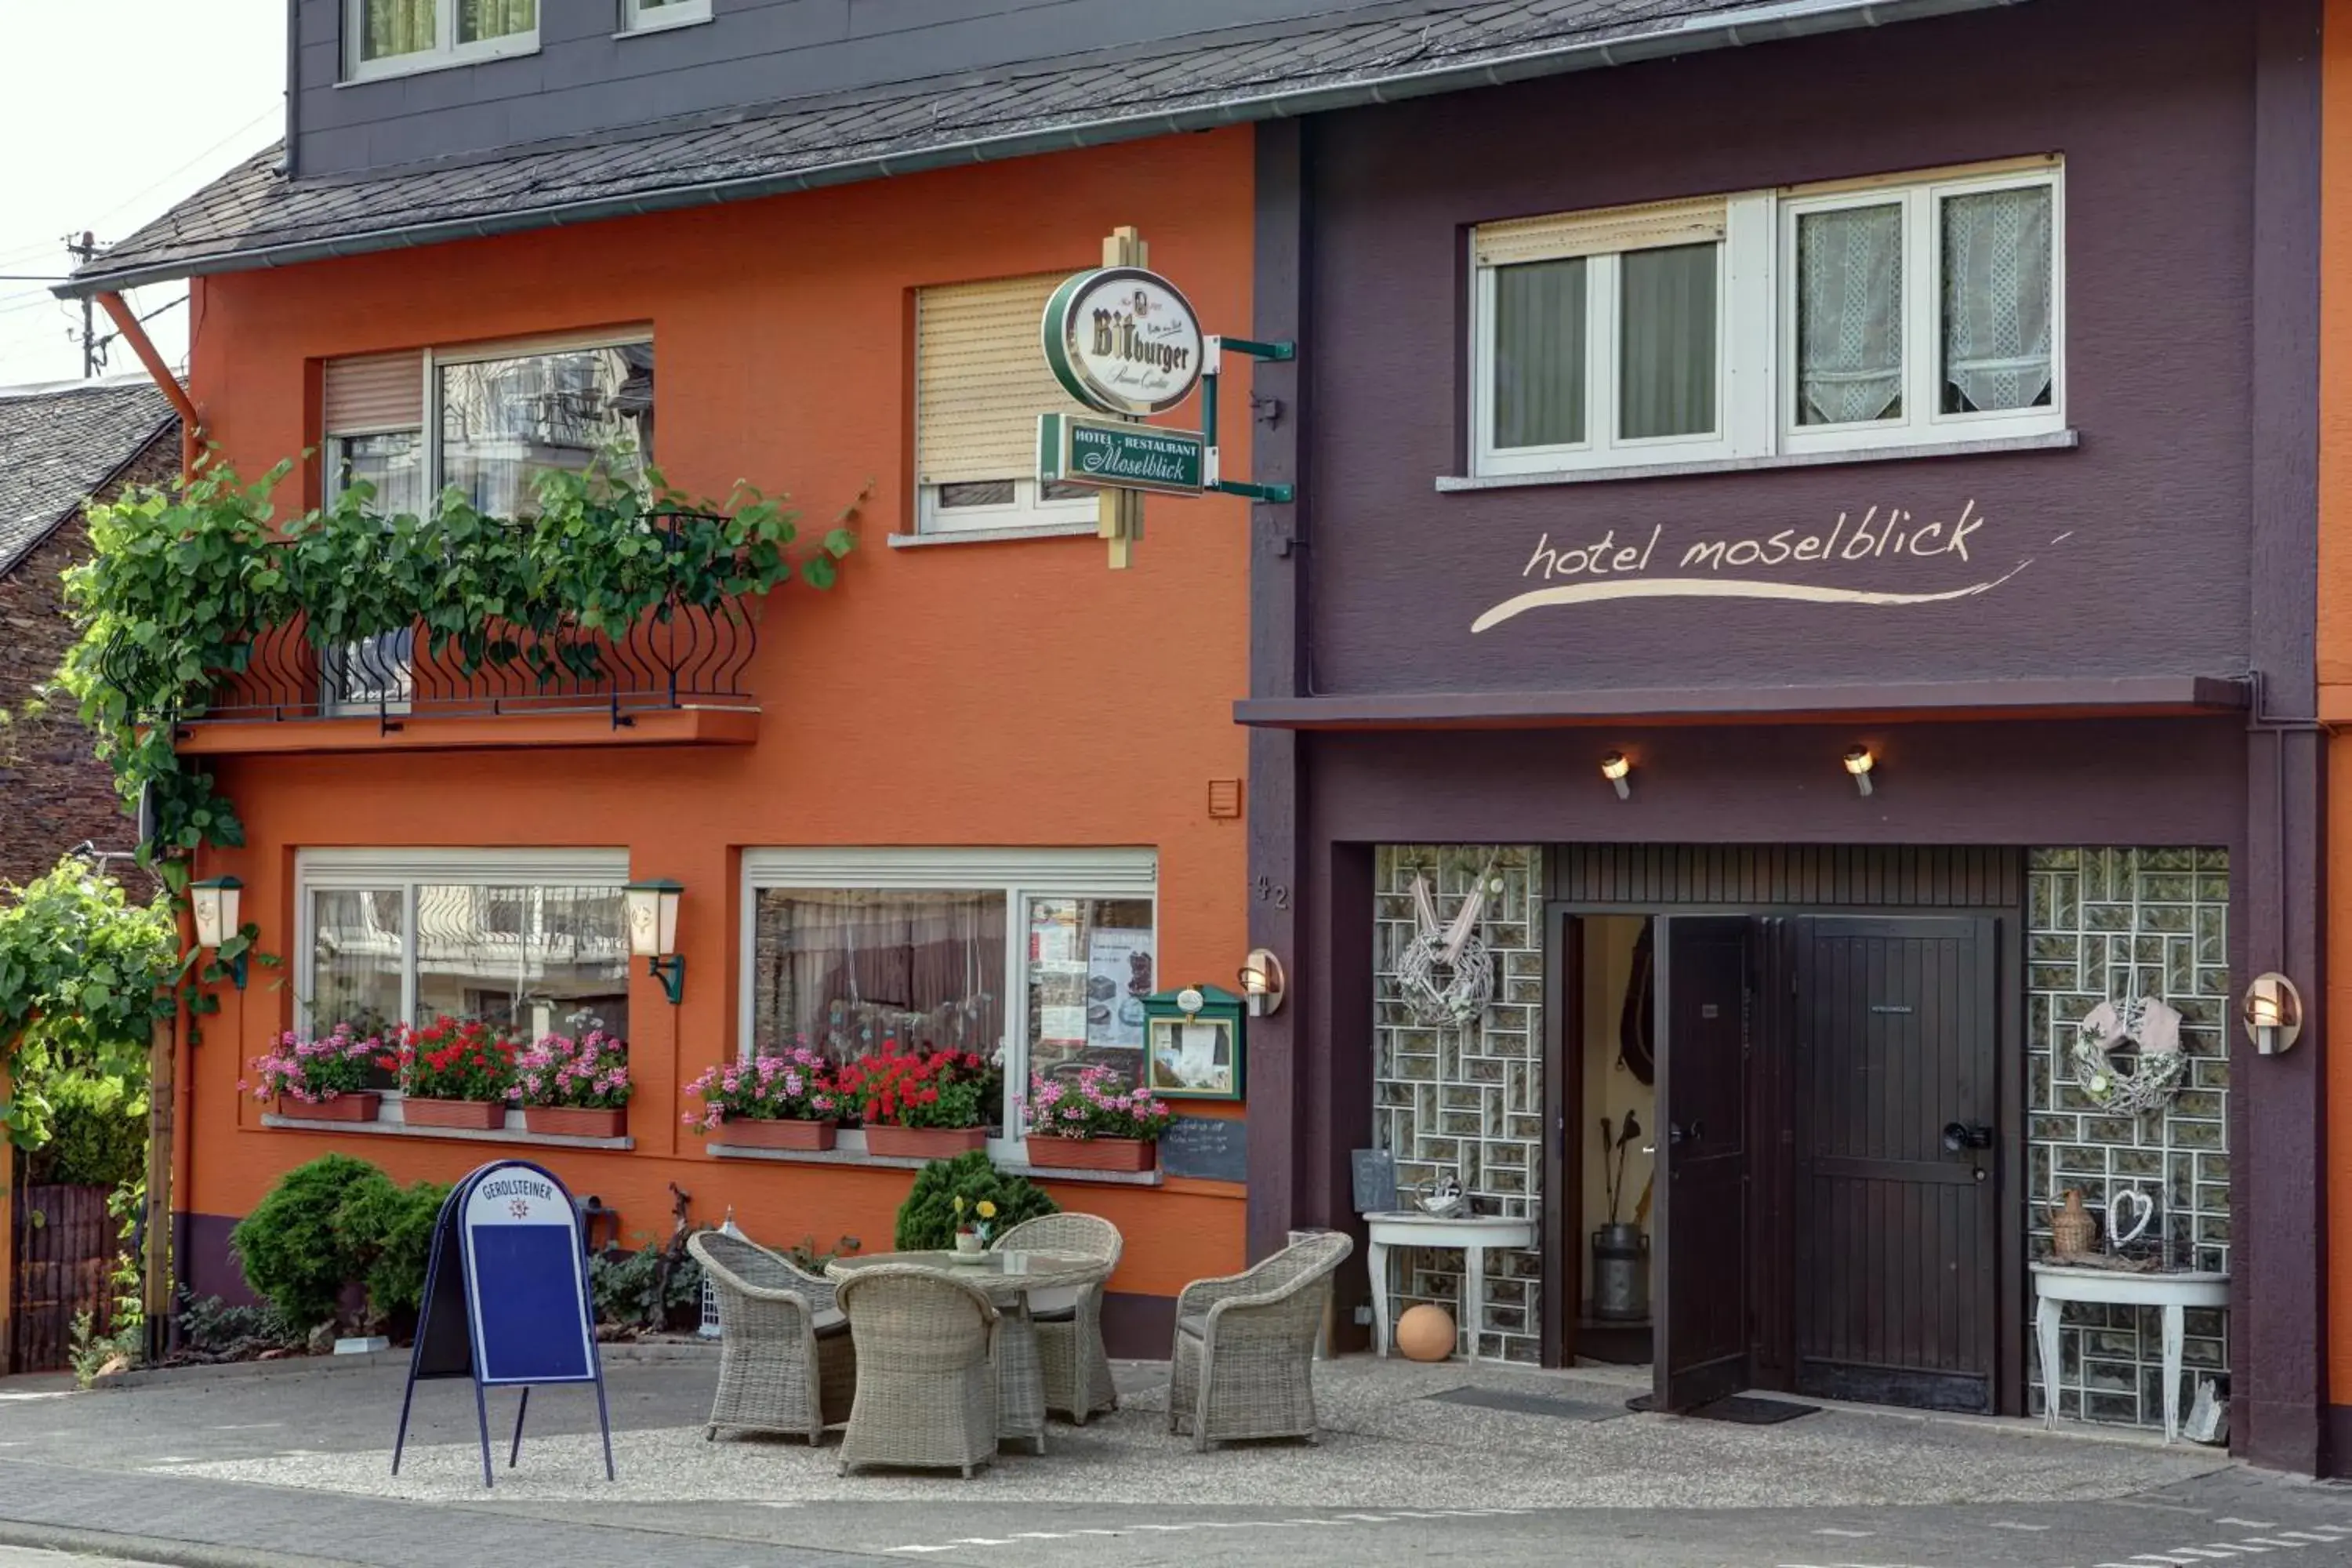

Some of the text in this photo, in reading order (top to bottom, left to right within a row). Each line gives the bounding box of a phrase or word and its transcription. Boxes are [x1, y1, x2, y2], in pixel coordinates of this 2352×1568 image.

[1091, 307, 1189, 374] Bitburger
[1076, 430, 1196, 456] HOTEL RESTAURANT
[1082, 445, 1185, 481] Moselblick
[1523, 499, 1985, 579] hotel moselblick
[1258, 874, 1288, 910] 42
[482, 1179, 553, 1201] GEROLSTEINER
